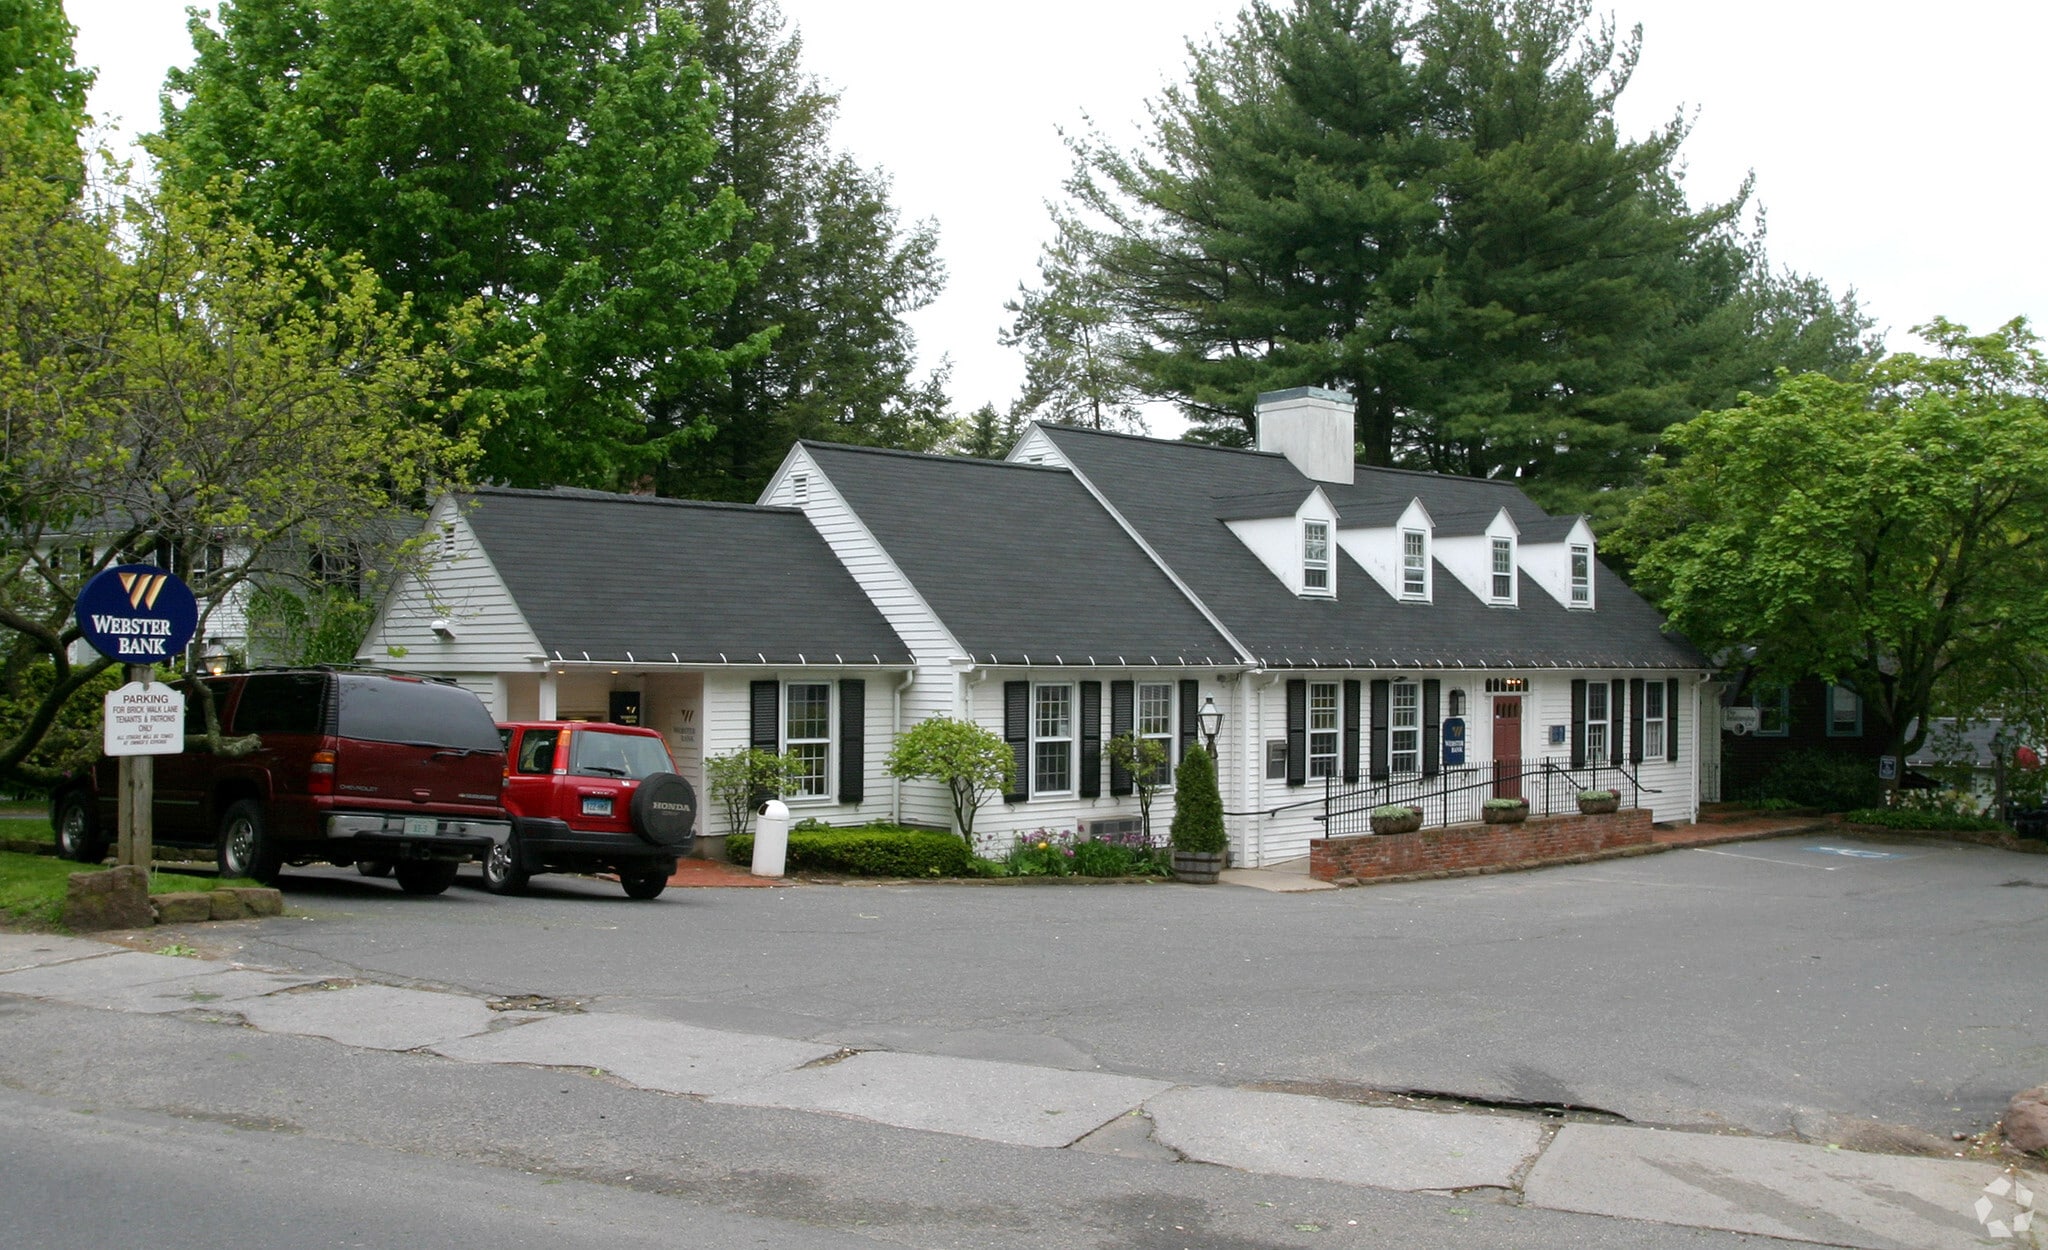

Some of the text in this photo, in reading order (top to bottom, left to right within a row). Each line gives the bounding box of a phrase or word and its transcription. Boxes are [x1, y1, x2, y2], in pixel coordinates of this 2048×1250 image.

[91, 614, 172, 636] WEBSTER
[118, 637, 166, 655] BANK
[123, 694, 169, 704] PARKING
[112, 705, 179, 714] FOR BRICK WALK LANE
[115, 714, 176, 724] TENANTS & PATRONS
[138, 724, 153, 732] ONLY
[338, 783, 379, 793] CHEVROLET
[652, 801, 691, 812] HONDA
